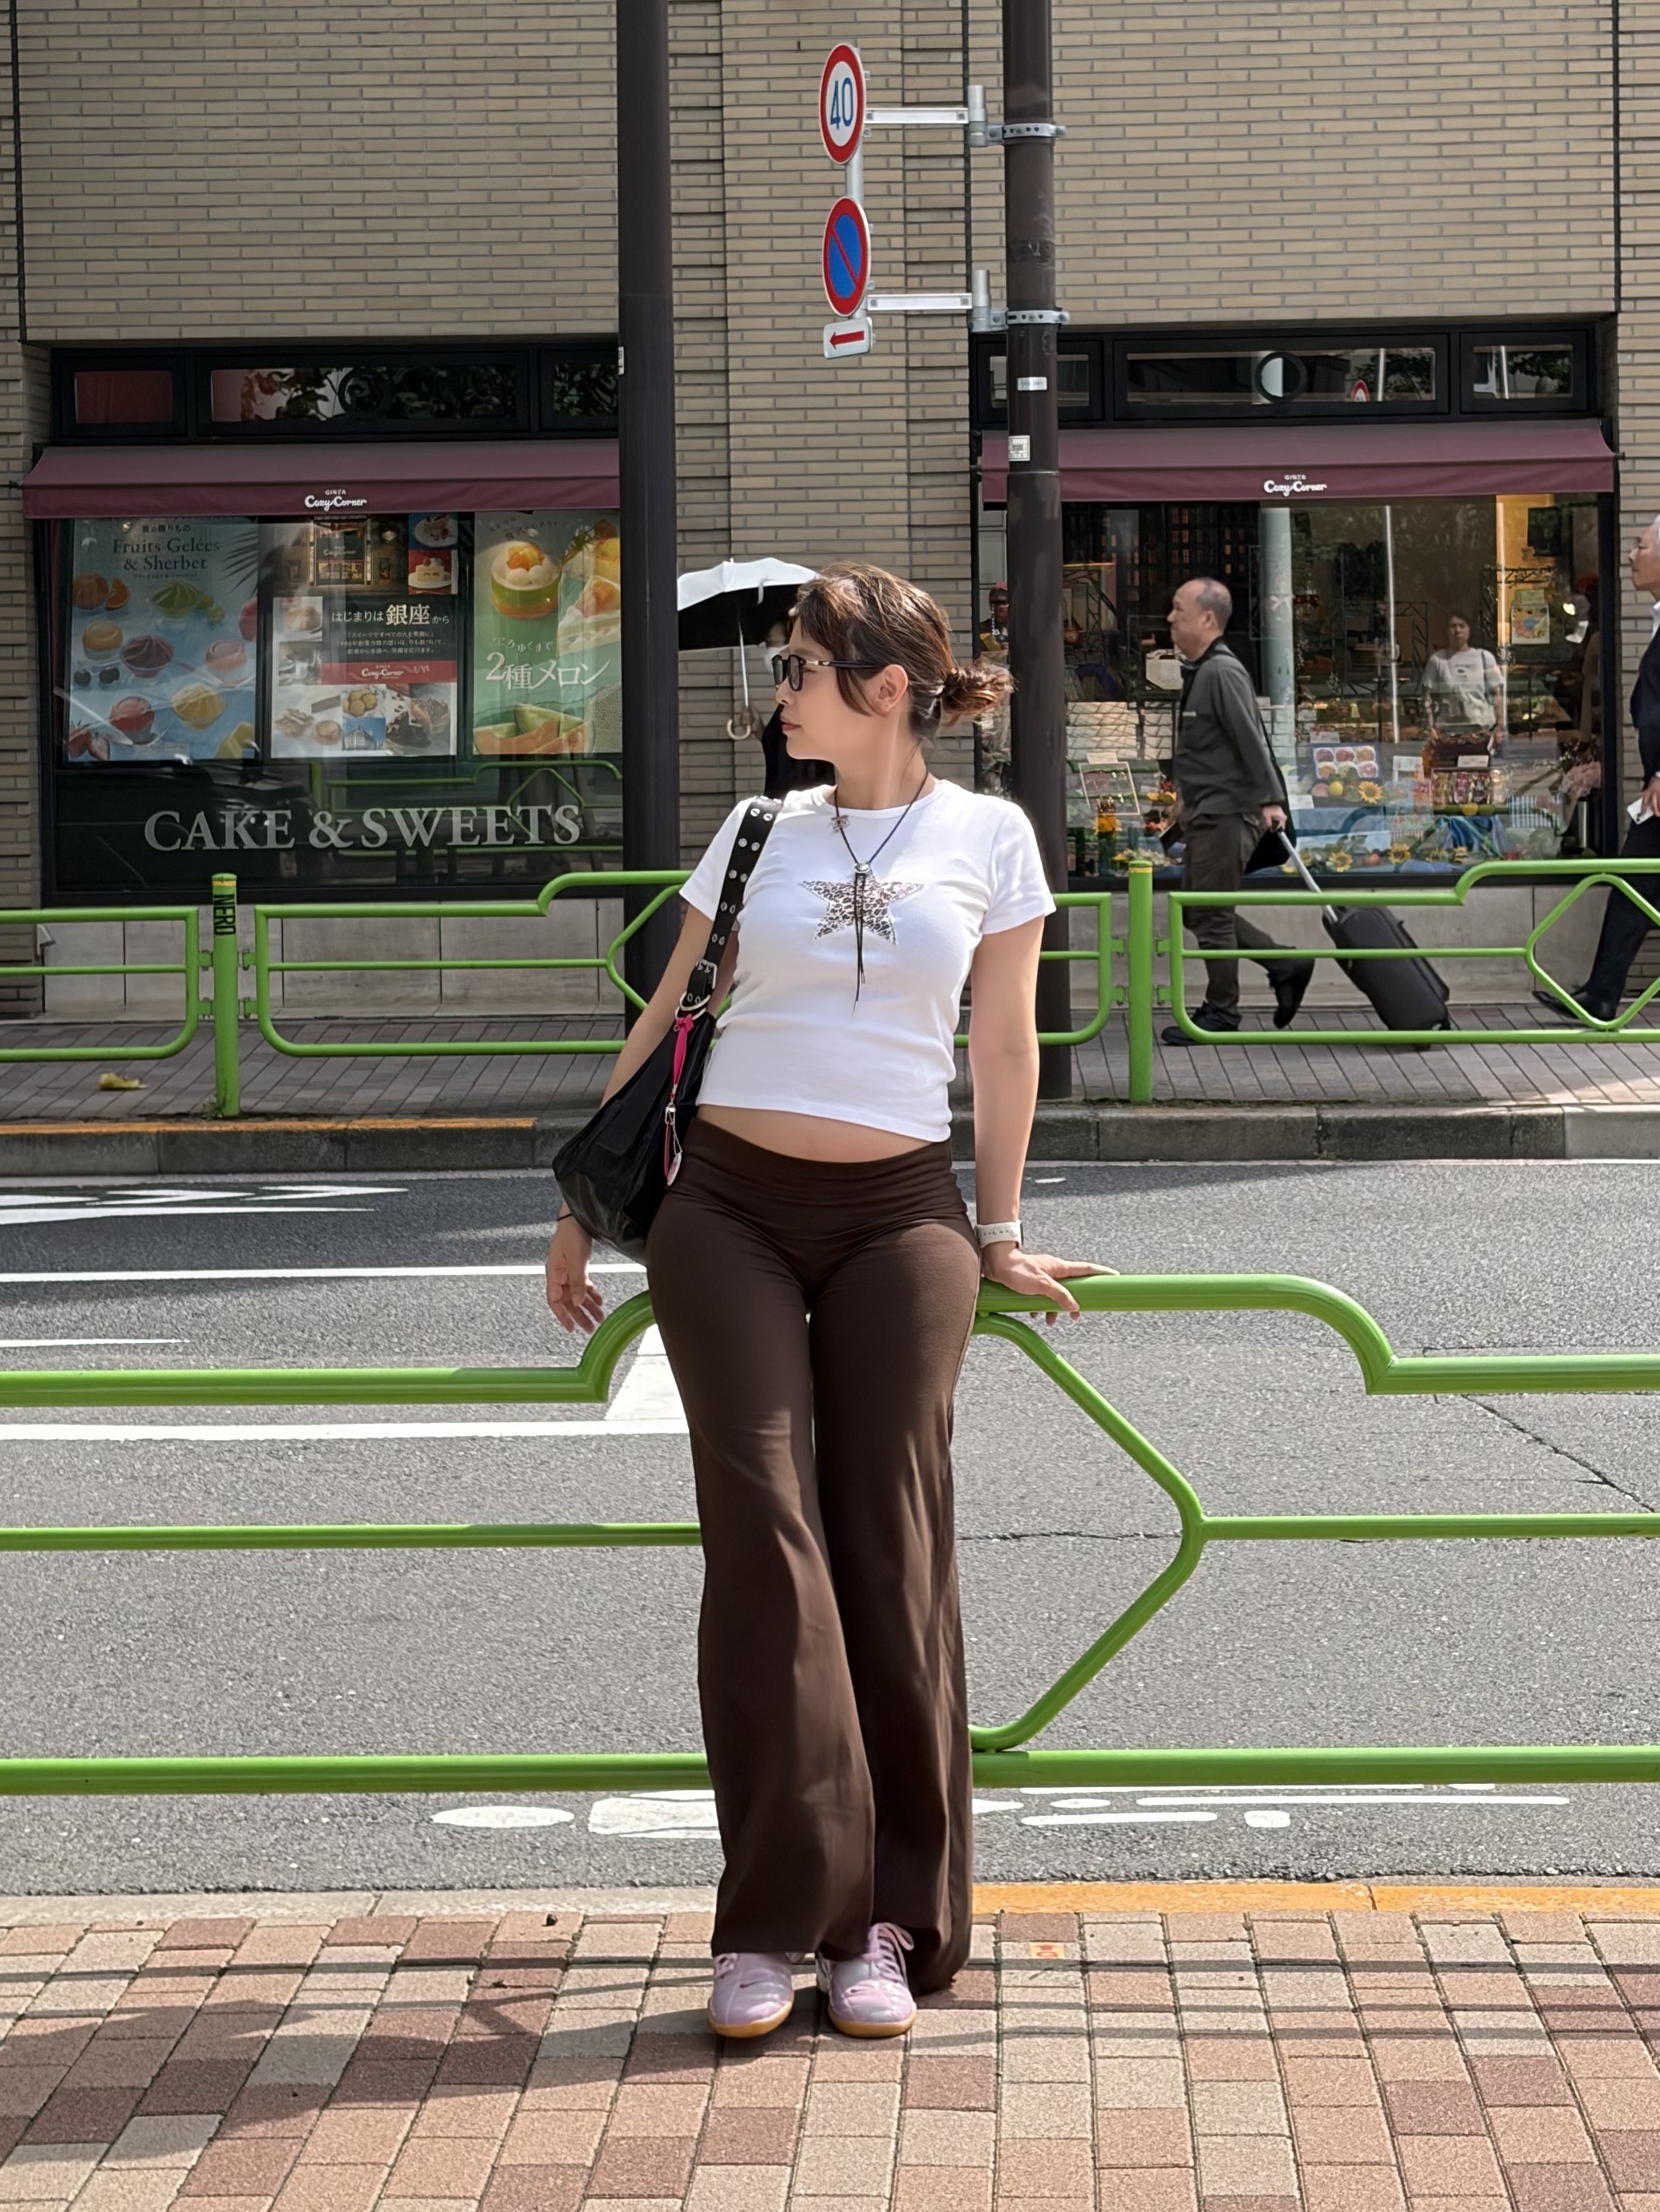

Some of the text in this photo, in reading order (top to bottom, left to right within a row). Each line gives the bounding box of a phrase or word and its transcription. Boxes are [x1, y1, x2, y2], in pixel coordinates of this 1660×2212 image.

[830, 77, 854, 130] 40
[1263, 479, 1328, 497] Cozy Corner
[304, 495, 368, 512] Cozy Corner
[112, 539, 161, 554] Fruits
[123, 555, 208, 571] & Sherbet
[331, 604, 450, 626] はじまりは銀座から
[486, 652, 611, 690] 2種メロン
[144, 804, 581, 851] CAKE & SWEETS
